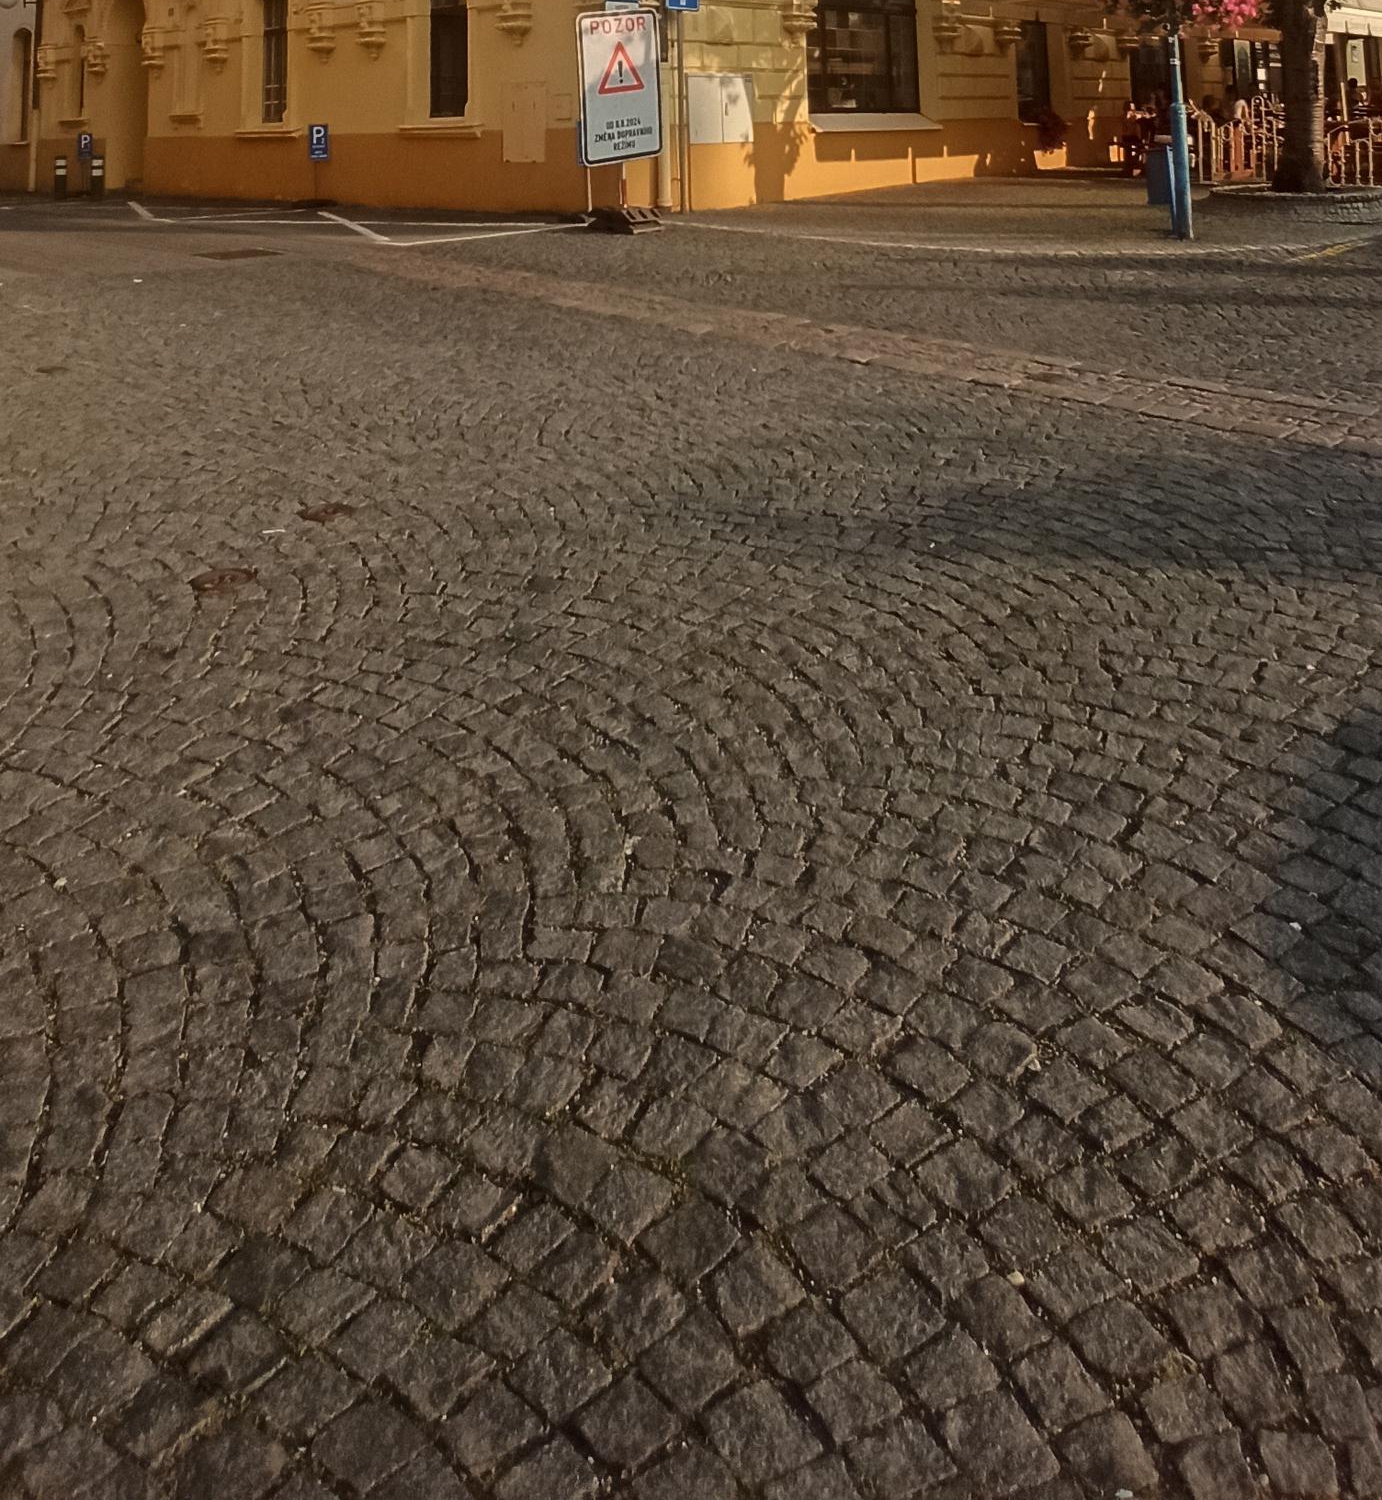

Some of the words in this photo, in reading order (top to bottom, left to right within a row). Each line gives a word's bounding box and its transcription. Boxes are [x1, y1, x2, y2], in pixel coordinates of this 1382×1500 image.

[590, 16, 646, 35] POZOR
[81, 135, 90, 149] P
[312, 126, 324, 144] P
